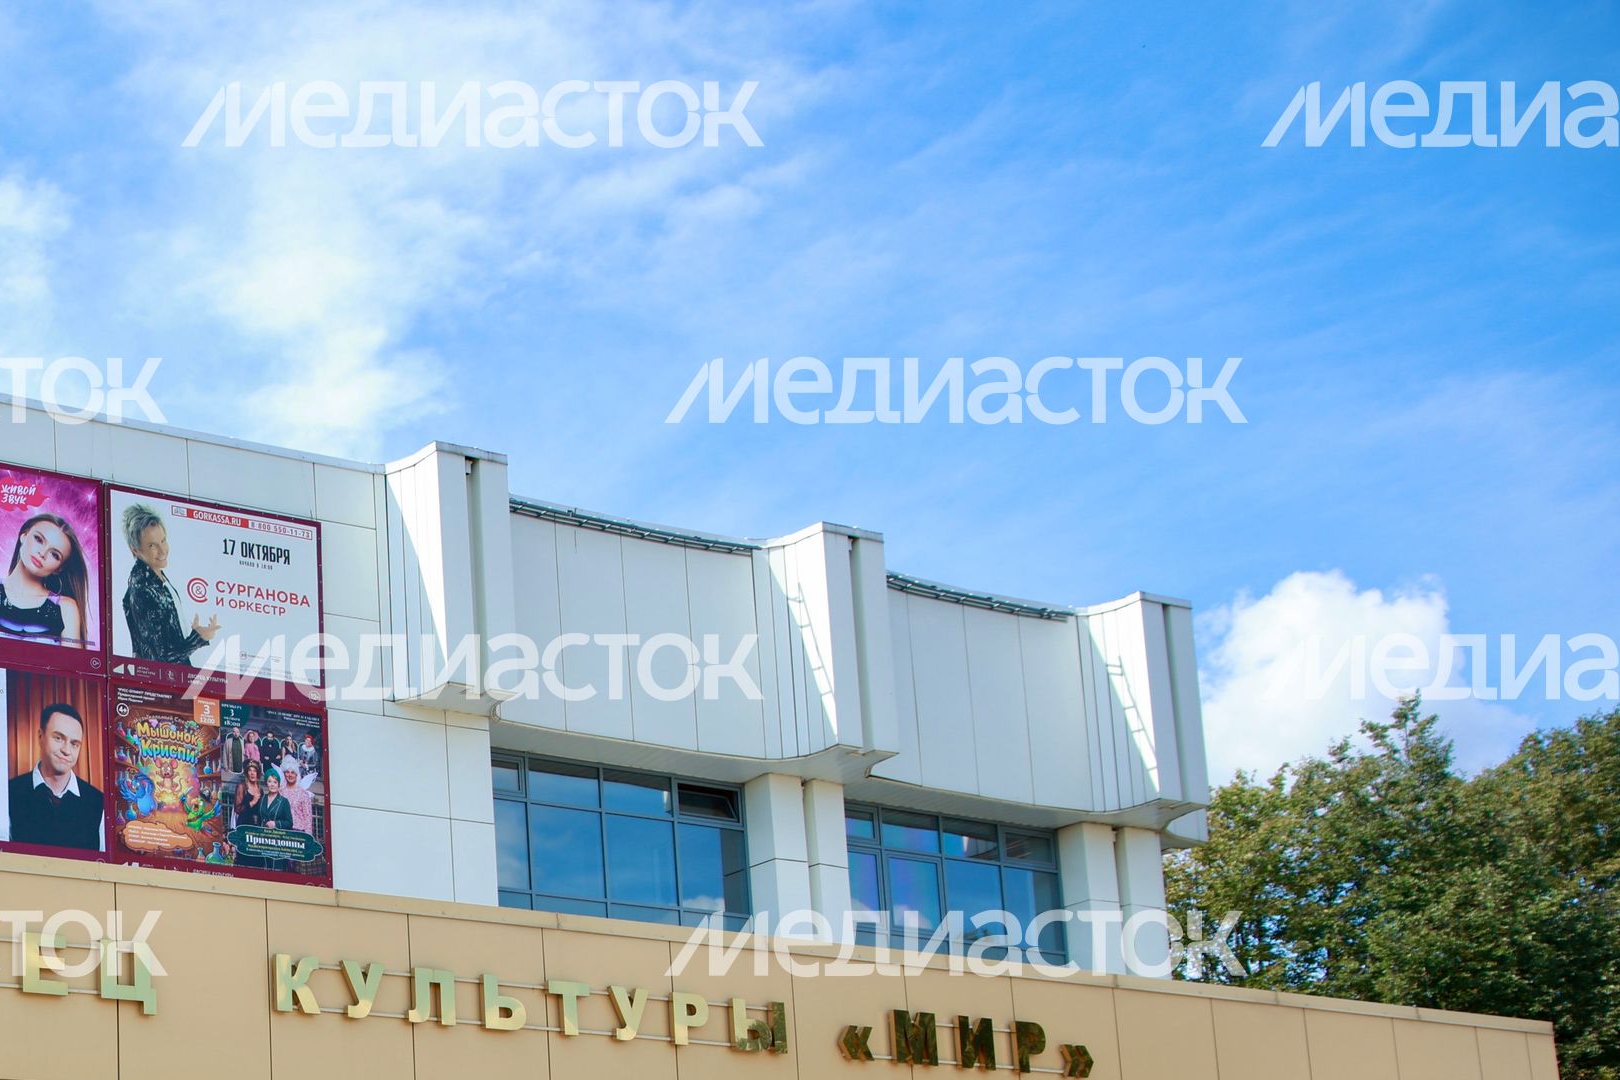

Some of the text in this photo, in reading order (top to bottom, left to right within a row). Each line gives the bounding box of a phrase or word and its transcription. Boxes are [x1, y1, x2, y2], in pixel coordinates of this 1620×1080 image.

[0, 483, 37, 496] ЖИВОЙ
[1, 494, 27, 505] ЗВУК
[193, 511, 242, 527] GORKASSA.RU
[258, 522, 271, 531] 800
[222, 538, 291, 565] 17 ОКТЯБРЯ
[215, 580, 310, 607] СУРГАНОВА
[216, 596, 286, 616] И ОРКЕСТР
[203, 705, 211, 714] 3
[136, 722, 201, 745] Мышонок
[141, 739, 198, 764] Криспи
[273, 953, 789, 1055] КУЛЬТУРЫ
[837, 1009, 1094, 1079] «МИР»
